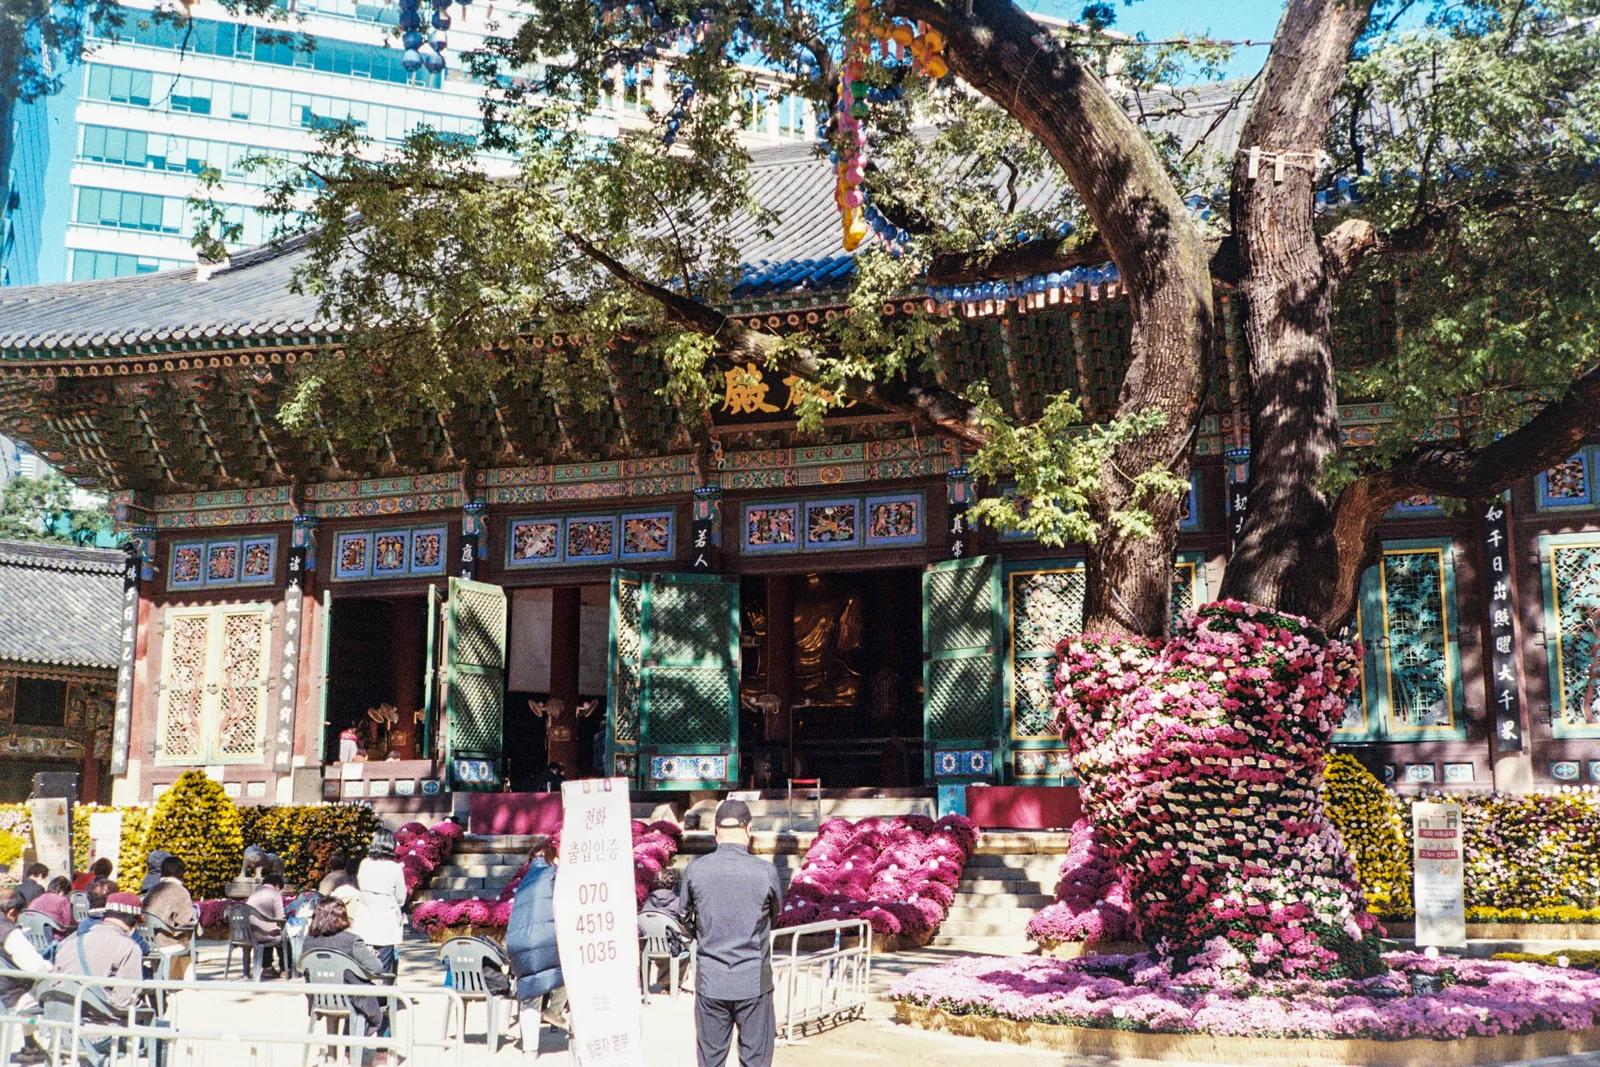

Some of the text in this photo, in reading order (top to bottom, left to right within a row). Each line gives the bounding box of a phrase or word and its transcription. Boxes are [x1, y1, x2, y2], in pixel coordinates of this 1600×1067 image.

[584, 807, 607, 831] 전화
[567, 838, 620, 865] 출입인증
[578, 882, 609, 906] 070
[576, 911, 615, 935] 4519
[578, 940, 618, 965] 1035
[611, 1032, 629, 1051] 명부
